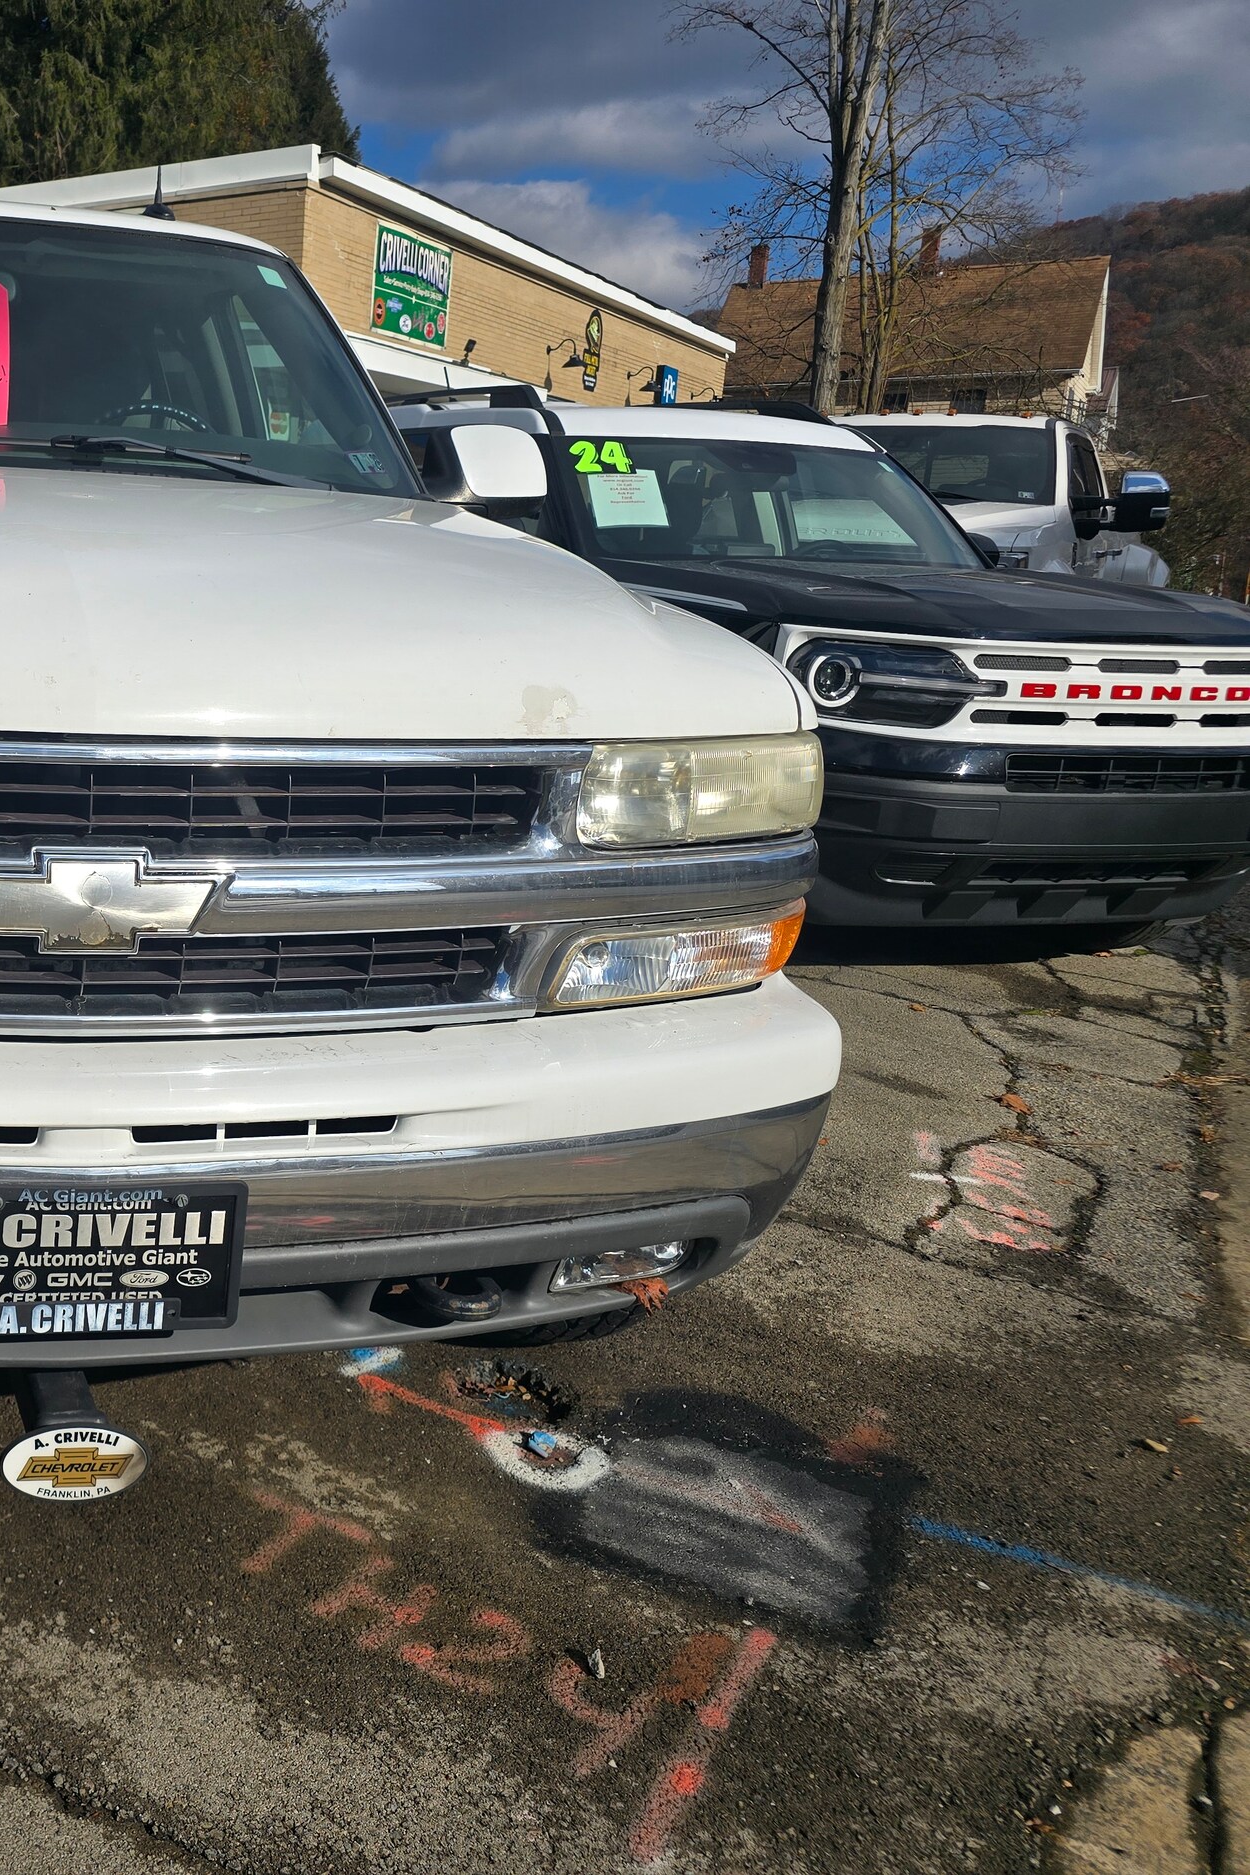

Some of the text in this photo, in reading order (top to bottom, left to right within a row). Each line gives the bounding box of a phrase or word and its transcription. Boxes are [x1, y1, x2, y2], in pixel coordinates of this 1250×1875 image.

[379, 231, 418, 274] CRIVELLI
[417, 245, 450, 296] CORNER
[662, 374, 676, 403] PPG
[569, 440, 633, 473] 24
[1020, 682, 1250, 701] BRONCO
[17, 1188, 163, 1203] AC Giant.com
[2, 1210, 227, 1248] CRIVELLI
[14, 1249, 136, 1267] Automotive
[141, 1249, 198, 1265] Giant
[46, 1272, 113, 1287] GMC
[30, 1302, 165, 1333] CRIVELLI
[34, 1431, 120, 1451] A. CRIVELLI
[31, 1462, 120, 1473] CHEVROLET
[36, 1486, 111, 1498] FRANKLIN, PA
